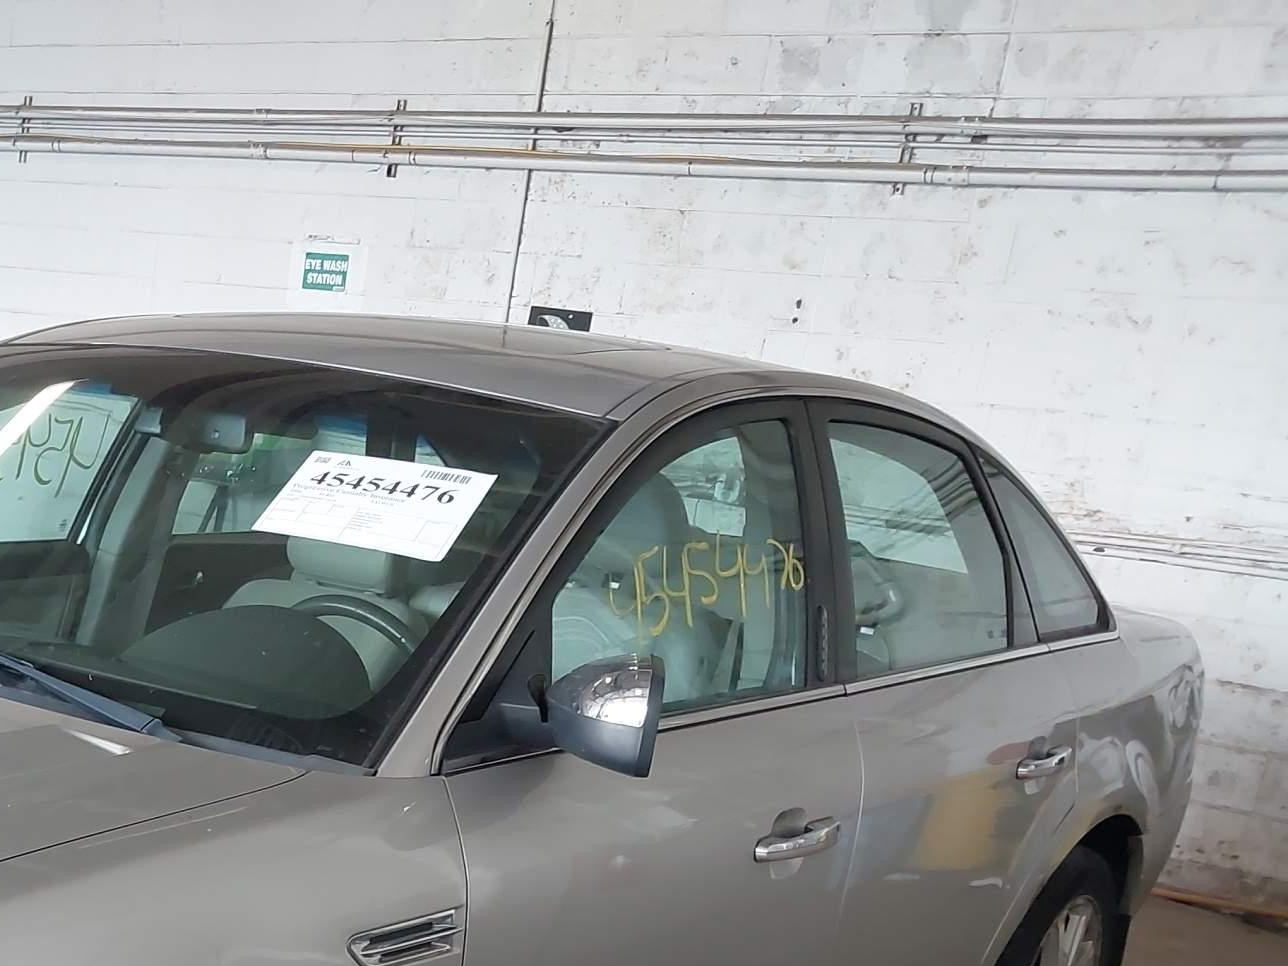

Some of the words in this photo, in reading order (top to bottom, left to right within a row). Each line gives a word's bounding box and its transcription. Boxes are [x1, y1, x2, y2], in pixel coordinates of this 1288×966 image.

[305, 258, 322, 270] EYE
[323, 259, 348, 272] WASH
[306, 272, 343, 285] STATION
[310, 471, 461, 504] 45454476
